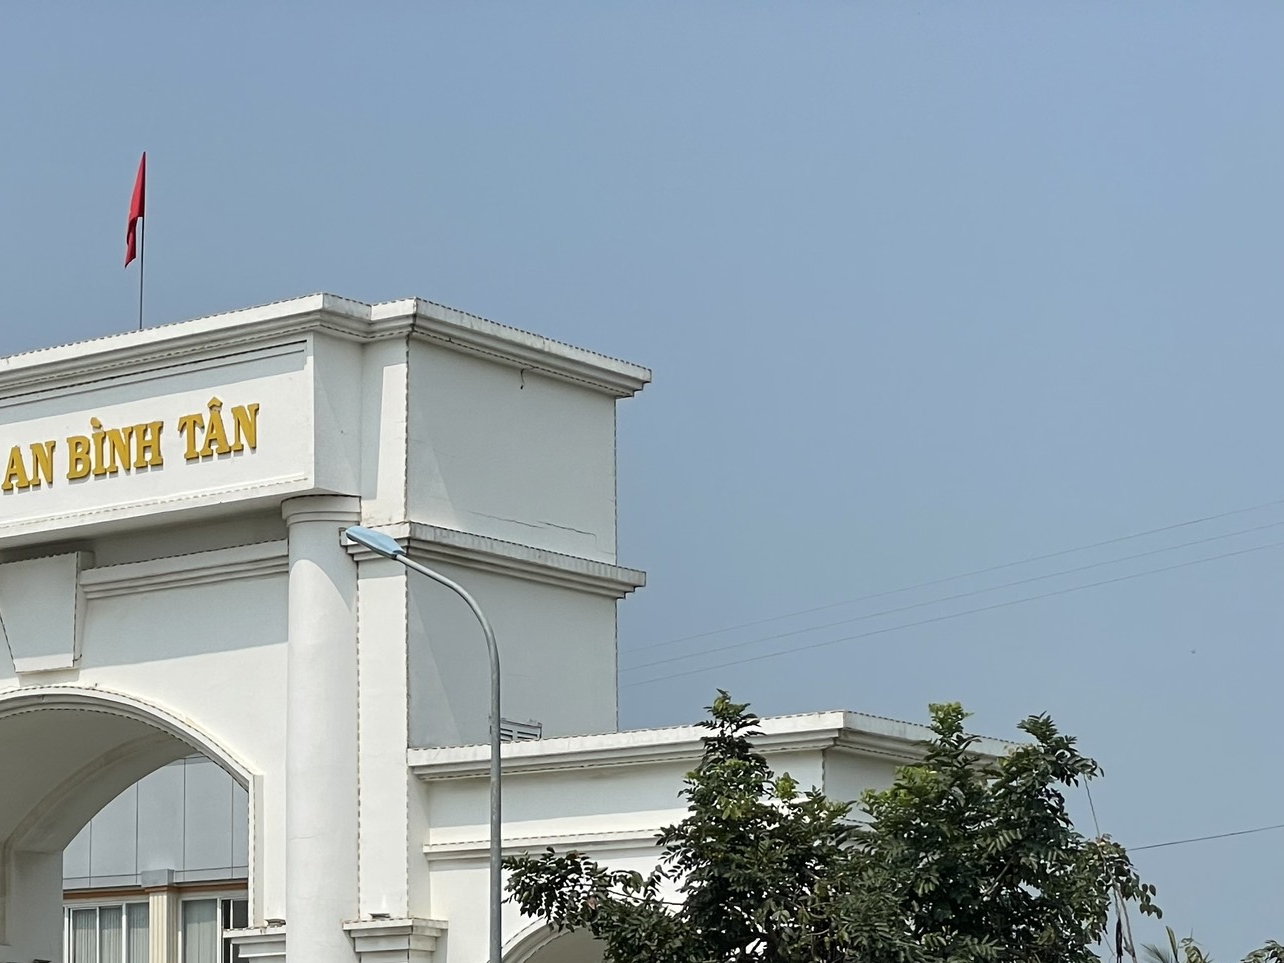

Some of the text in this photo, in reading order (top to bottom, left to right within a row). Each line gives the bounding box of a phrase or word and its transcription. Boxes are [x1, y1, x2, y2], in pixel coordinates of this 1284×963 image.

[1, 440, 56, 491] AN
[66, 416, 164, 479] BÌNH
[177, 396, 261, 461] TÂN
